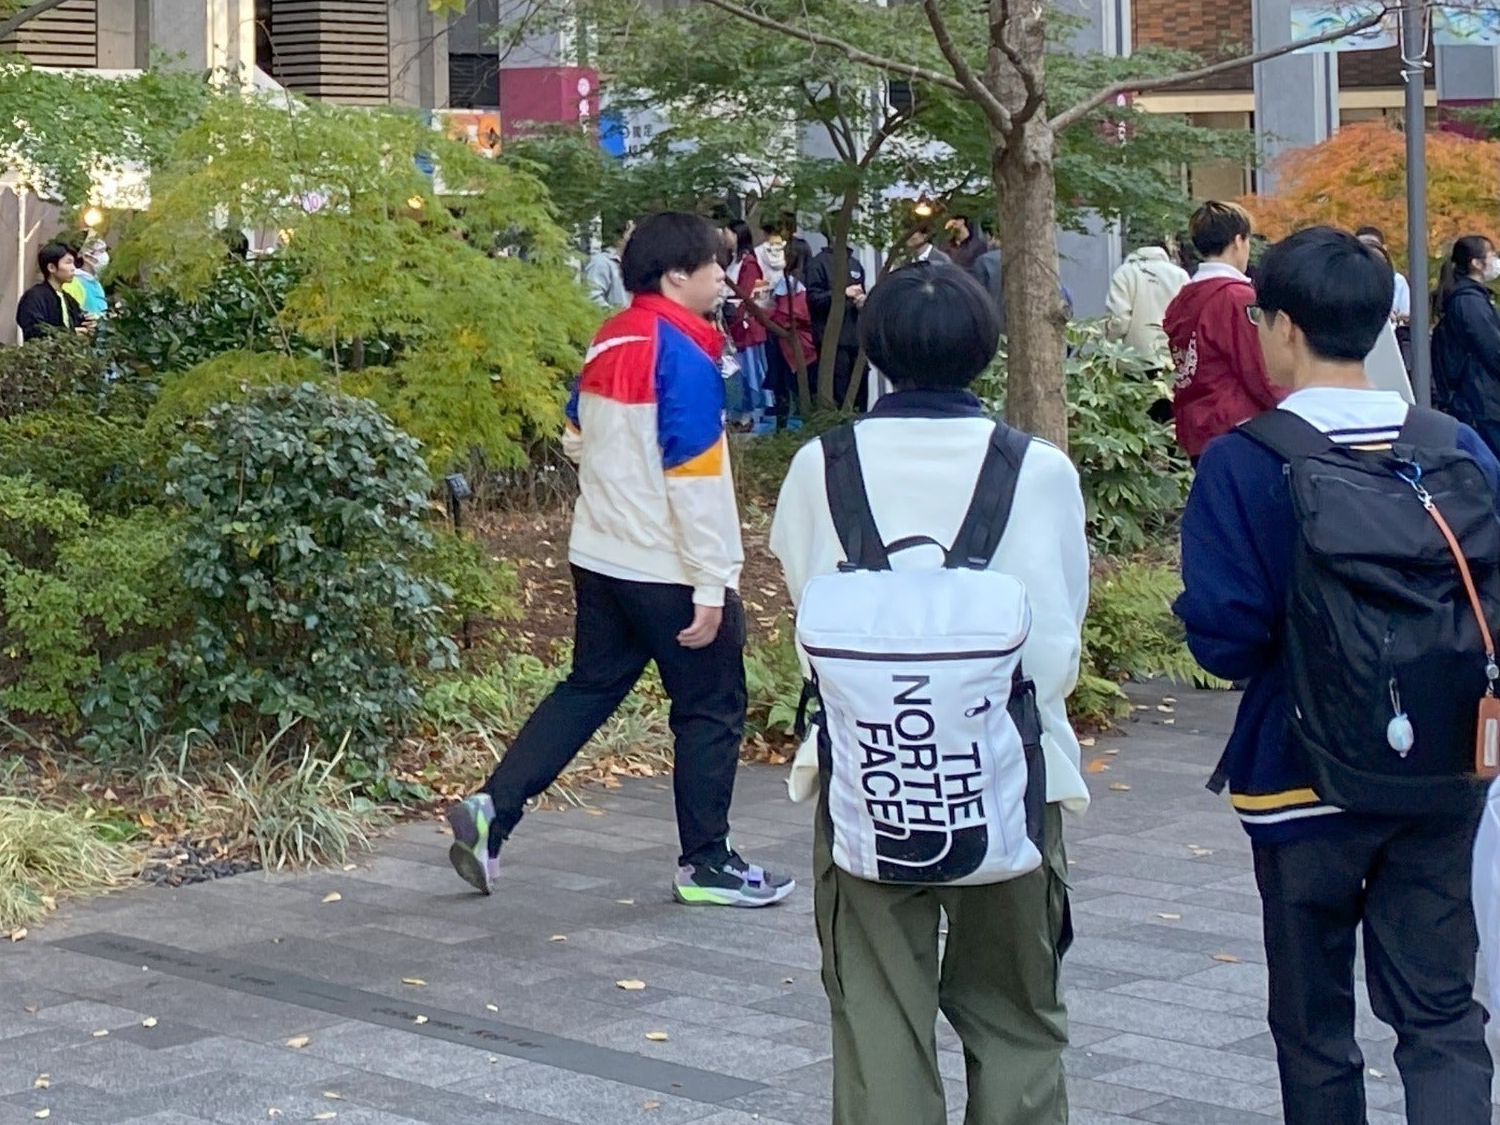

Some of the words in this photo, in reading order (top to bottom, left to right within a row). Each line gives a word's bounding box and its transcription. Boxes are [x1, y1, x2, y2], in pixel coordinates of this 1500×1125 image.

[856, 719, 908, 825] FACE
[891, 674, 947, 828] NORTH
[941, 741, 987, 826] THE
